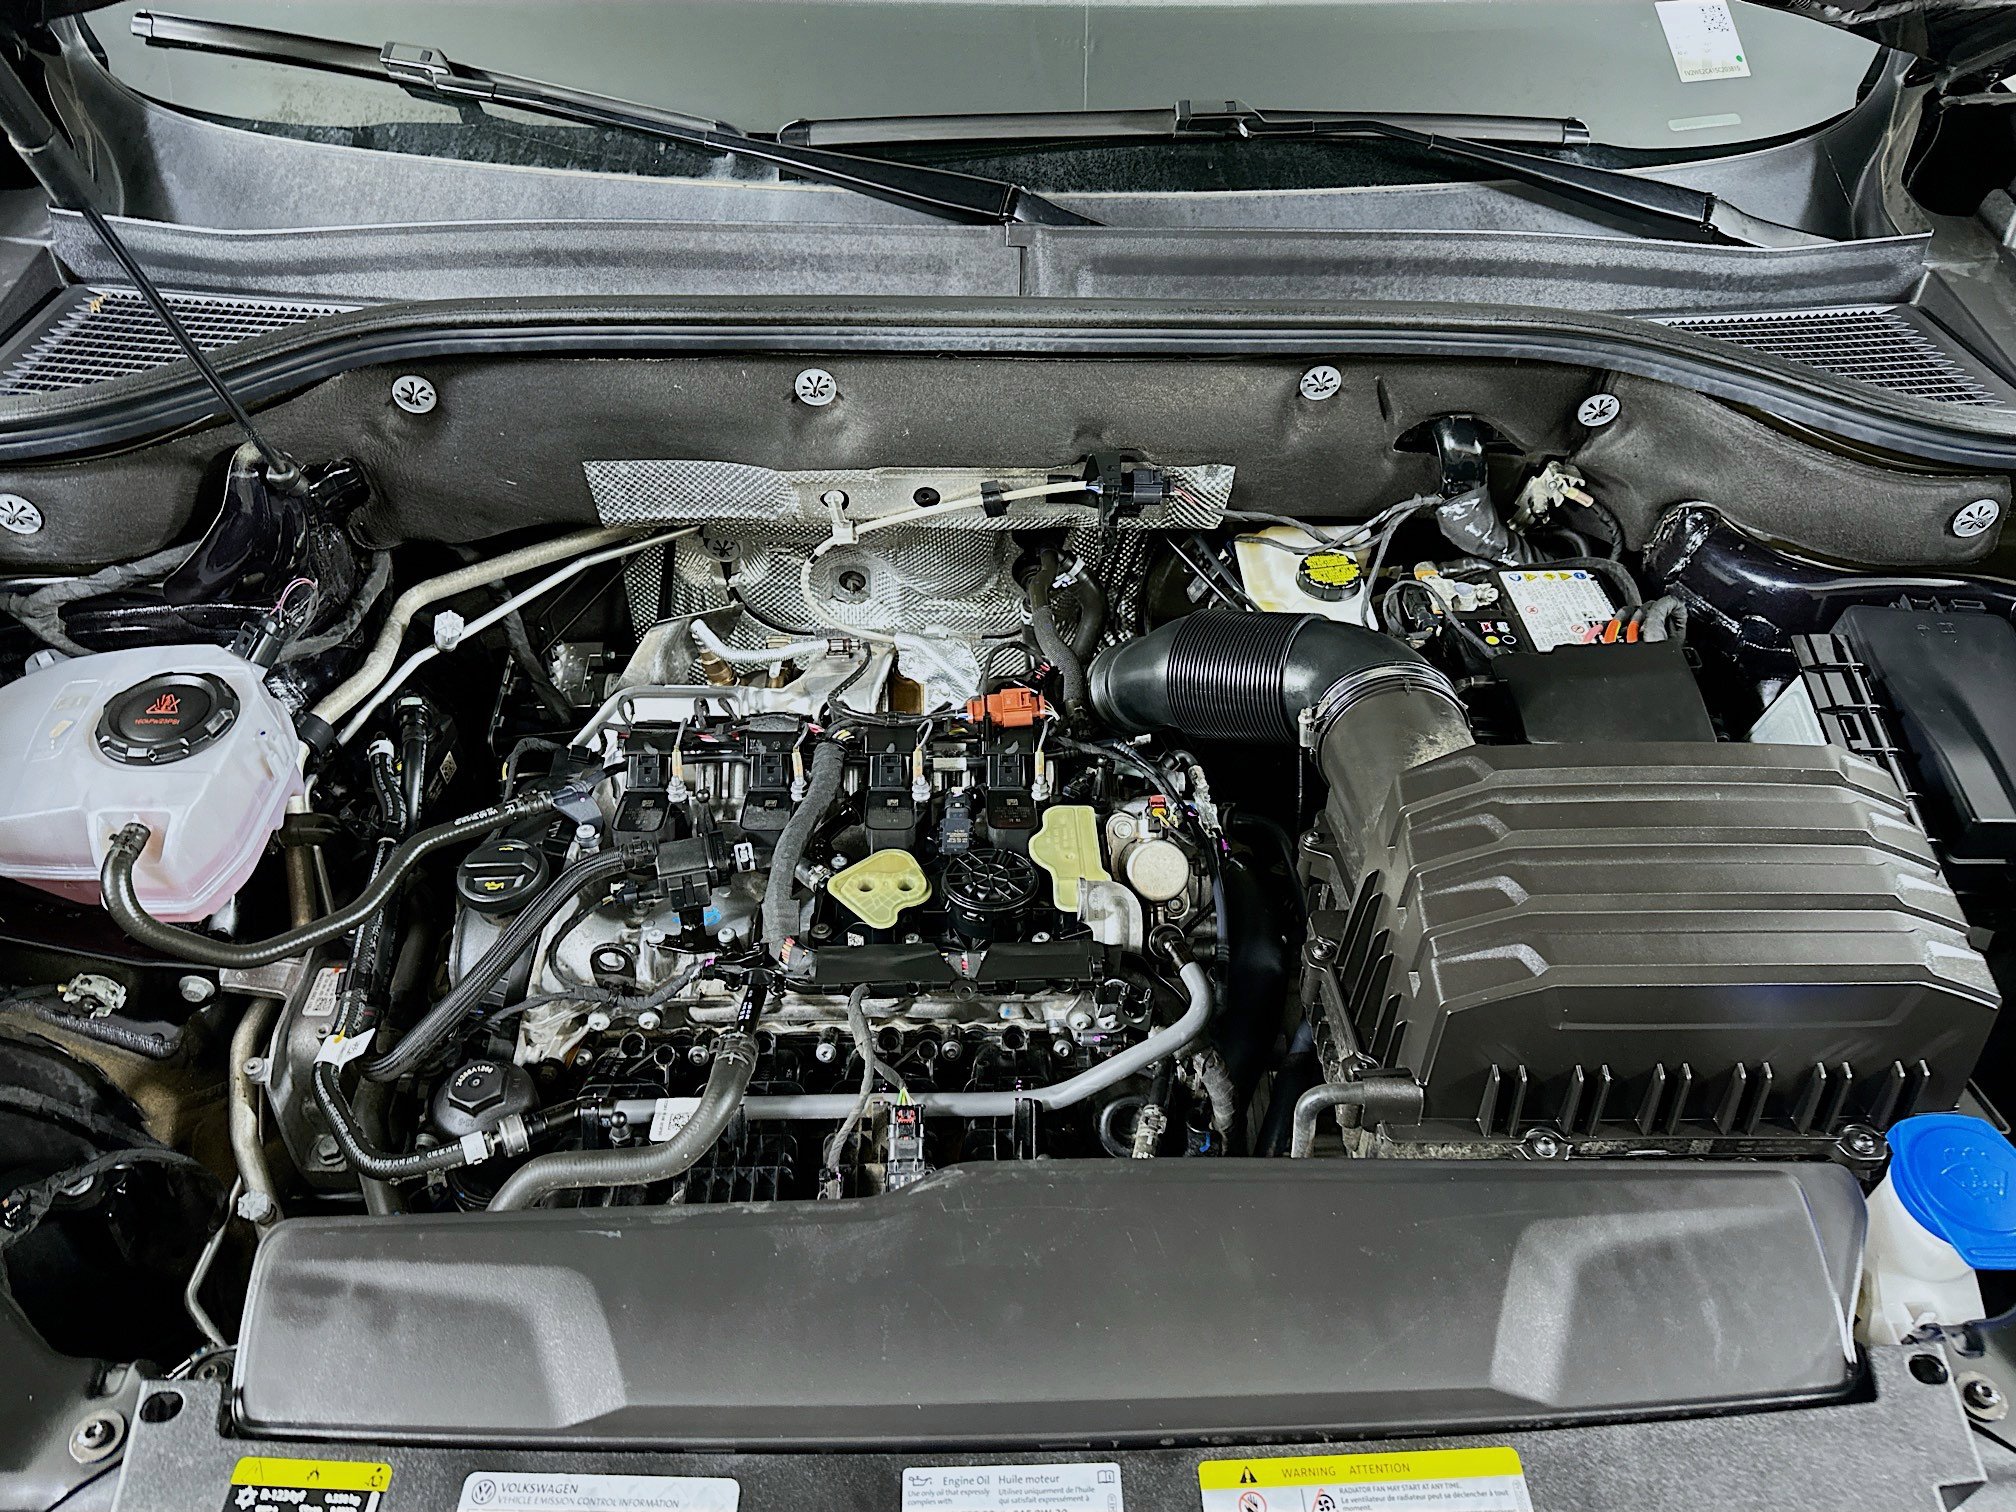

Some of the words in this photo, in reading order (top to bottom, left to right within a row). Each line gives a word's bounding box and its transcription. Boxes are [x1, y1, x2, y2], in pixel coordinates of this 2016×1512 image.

[1282, 1466, 1336, 1478] WARNING
[1349, 1462, 1411, 1475] ATTENTION
[943, 1476, 974, 1488] Engine
[977, 1475, 990, 1485] Oil
[998, 1474, 1023, 1484] Huile
[1025, 1475, 1060, 1484] moteur
[501, 1483, 579, 1494] VOLKSWAGEN
[921, 1490, 935, 1499] only
[960, 1488, 990, 1497] expressly
[1024, 1487, 1064, 1496] uniquement
[1065, 1486, 1074, 1494] de
[1339, 1486, 1371, 1494] RADIATOR
[1387, 1484, 1400, 1492] MAY
[497, 1495, 531, 1505] VEHICLE
[533, 1496, 575, 1506] EMISSION
[577, 1497, 617, 1507] CONTROL
[620, 1498, 680, 1508] INFORMATION
[907, 1499, 936, 1507] complies
[998, 1497, 1009, 1505] qui
[1350, 1495, 1385, 1503] ventilateur
[1387, 1494, 1395, 1502] de
[1396, 1493, 1426, 1501] radiateur
[1428, 1492, 1443, 1501] peut
